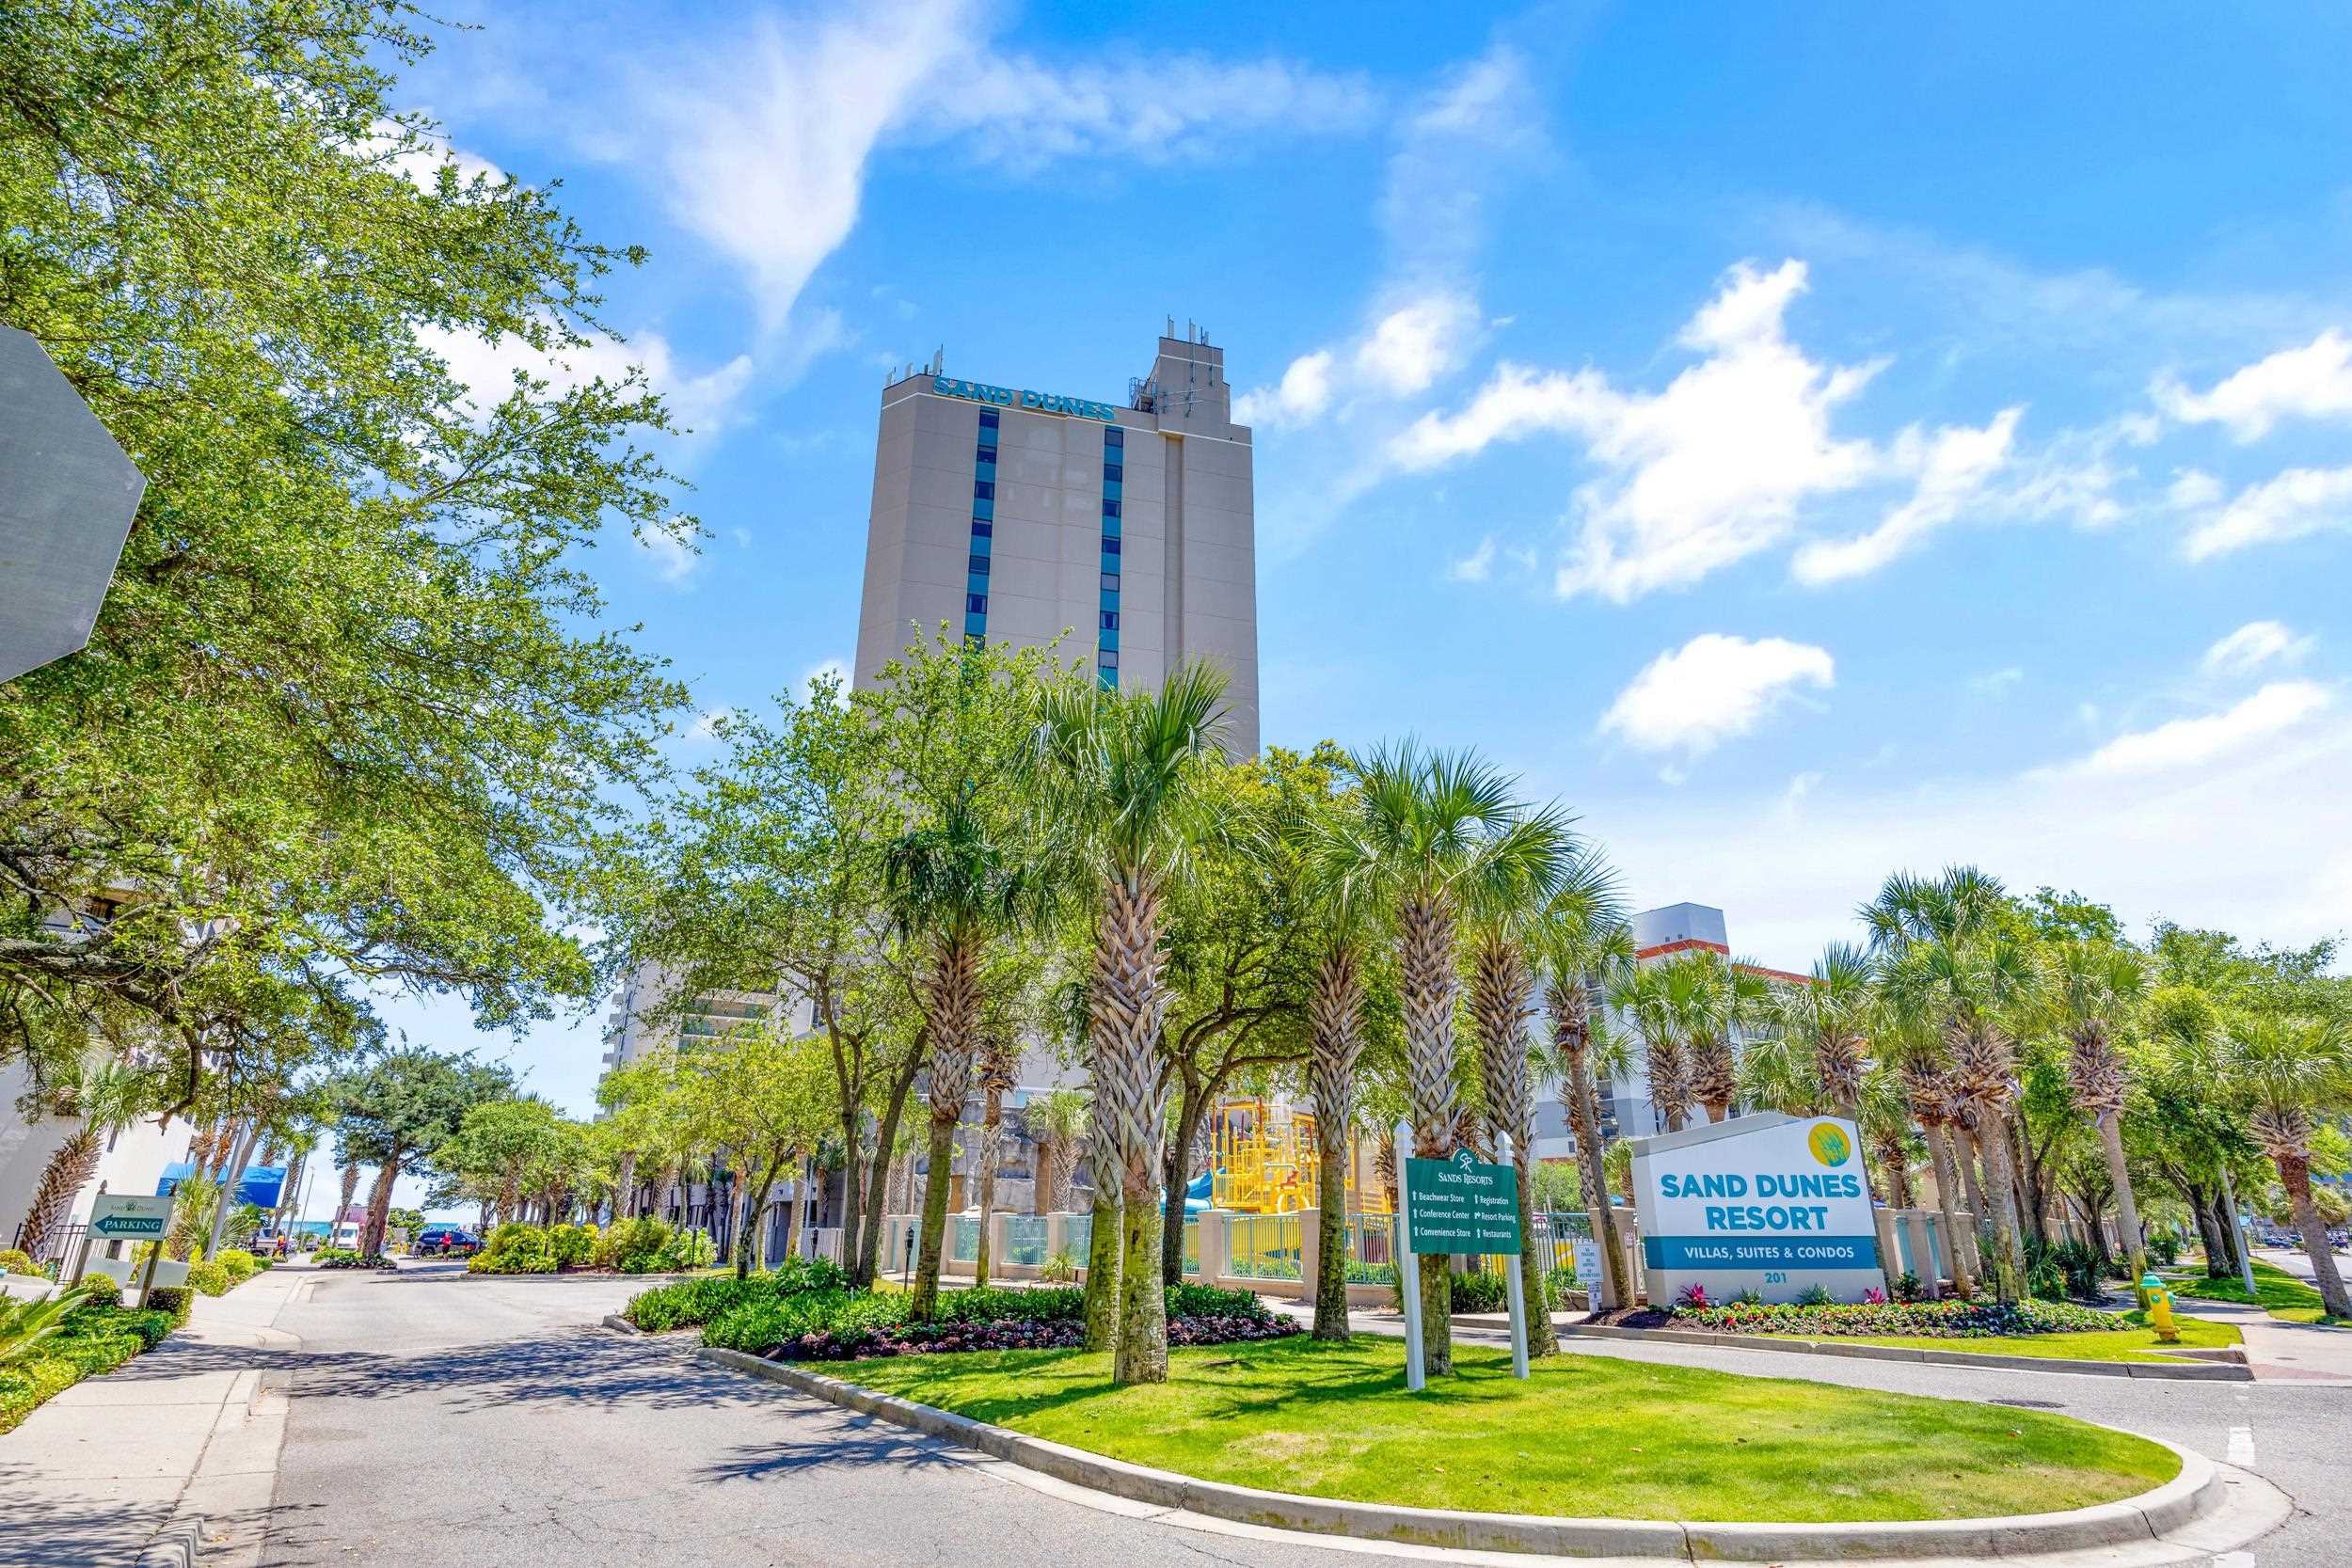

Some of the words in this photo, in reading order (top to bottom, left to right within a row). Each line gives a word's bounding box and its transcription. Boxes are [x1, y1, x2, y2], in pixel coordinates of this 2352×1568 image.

[933, 376, 1014, 406] SAND
[1022, 389, 1115, 421] DUNES
[1438, 1172, 1462, 1182] SANDS
[1464, 1174, 1493, 1185] RESORTS
[1661, 1174, 1747, 1197] SAND
[1756, 1174, 1861, 1198] DUNES
[1419, 1191, 1449, 1202] Beachwear
[1450, 1194, 1465, 1203] Store
[1480, 1196, 1509, 1206] Registration
[1419, 1209, 1451, 1219] Conference
[1452, 1211, 1470, 1220] Center
[1482, 1212, 1497, 1221] Resort
[1498, 1213, 1517, 1224] Parking
[1706, 1206, 1828, 1230] RESORT
[103, 1220, 160, 1229] PARKING
[1420, 1227, 1456, 1237] Convenience
[1456, 1228, 1470, 1238] Store
[1483, 1229, 1512, 1239] Restaurants
[1684, 1246, 1733, 1259] VILLAS,
[1736, 1246, 1780, 1259] SUITES
[1784, 1247, 1793, 1259] &
[1797, 1246, 1854, 1259] CONDOS
[1764, 1273, 1788, 1284] 201
